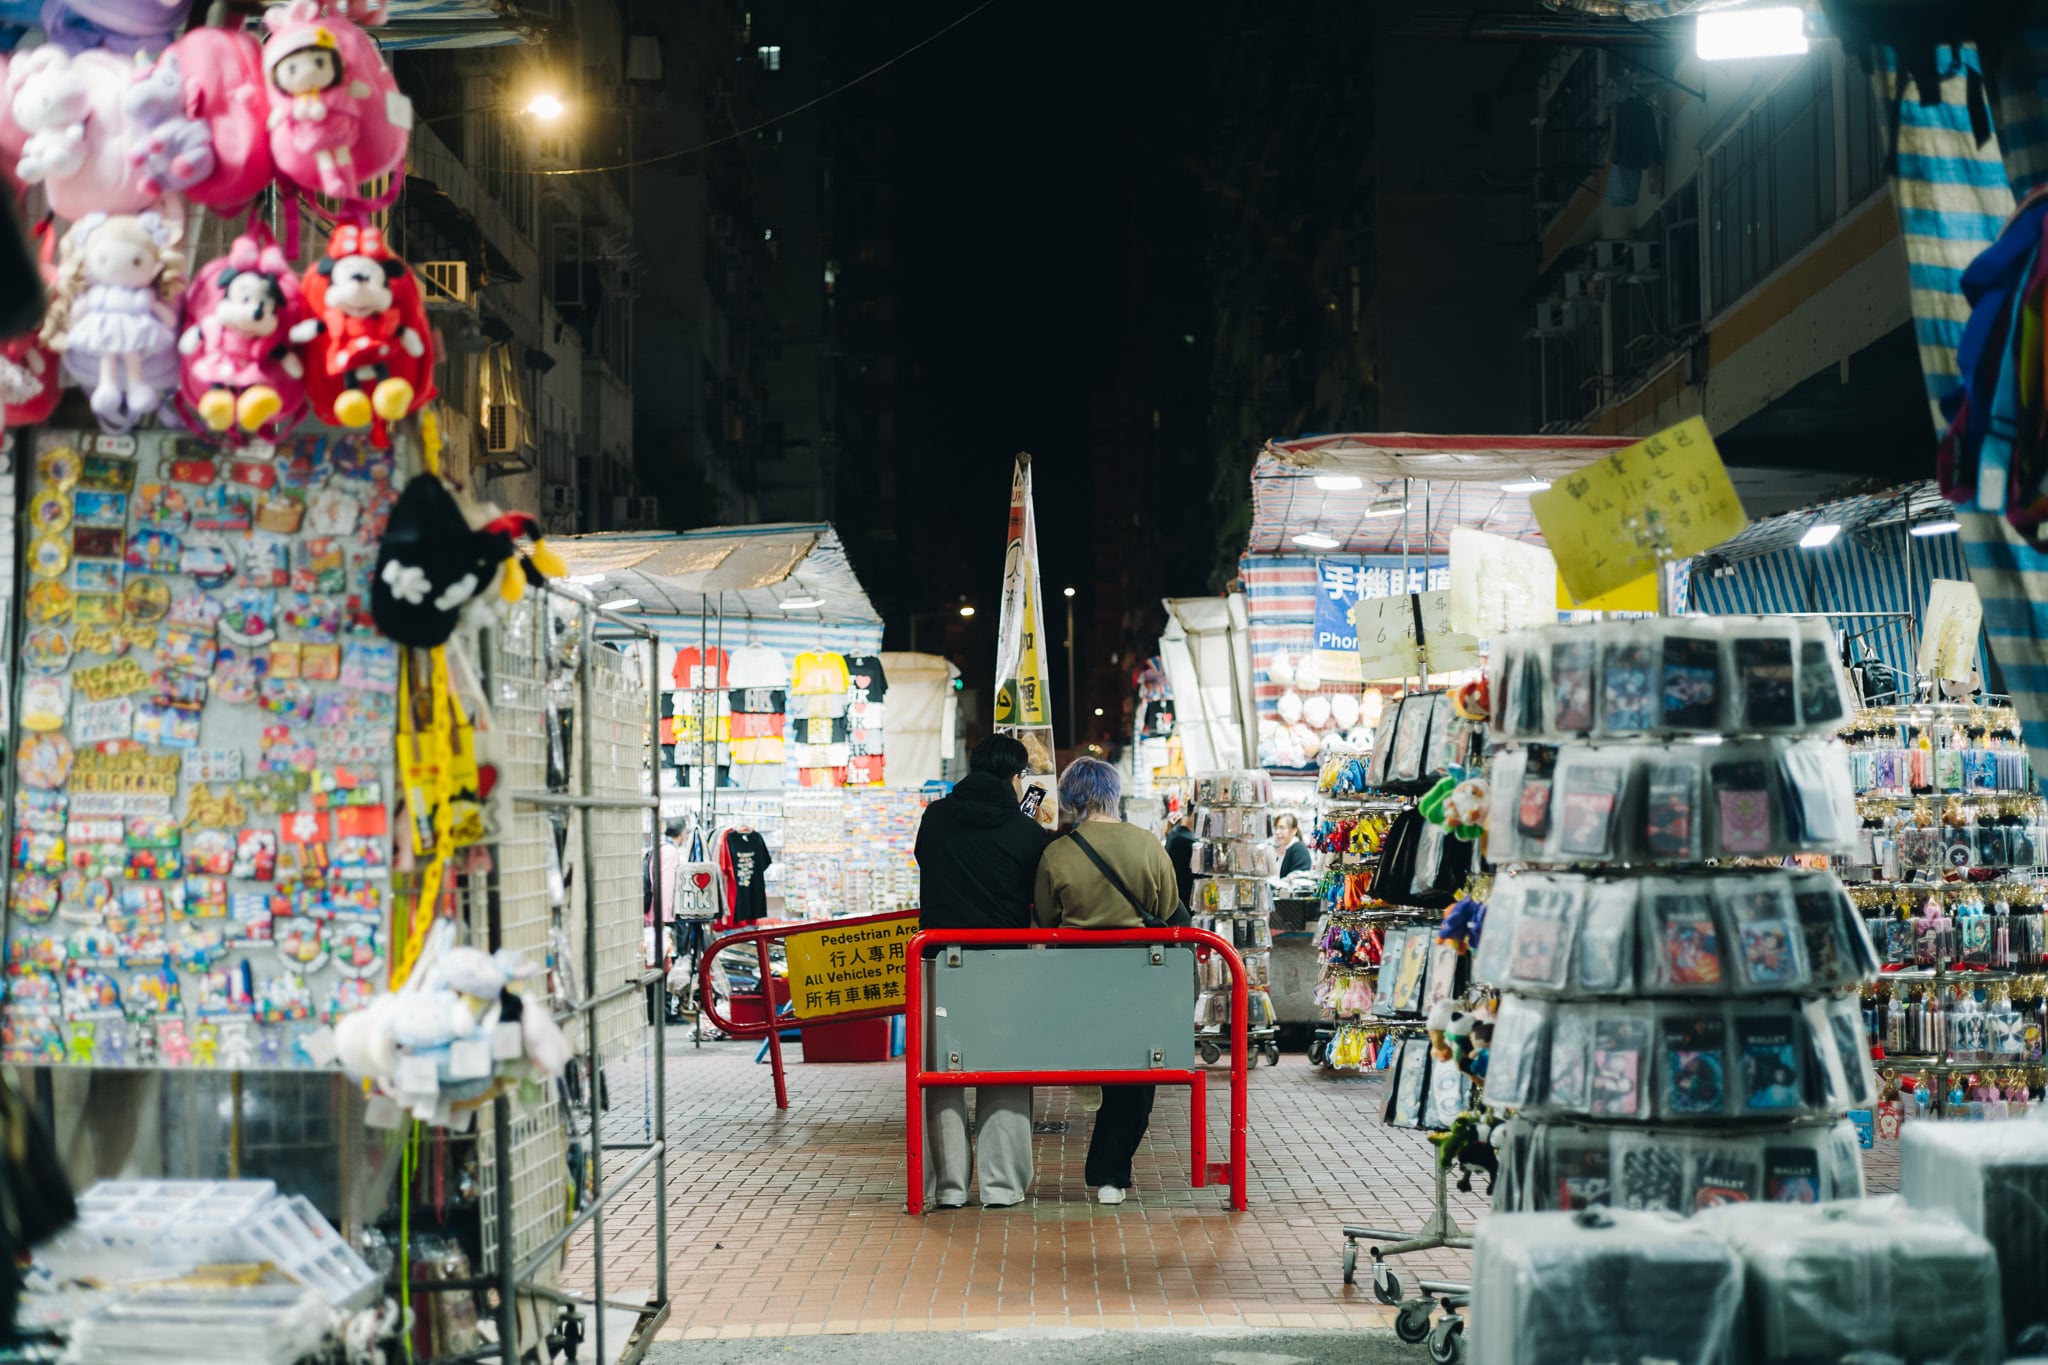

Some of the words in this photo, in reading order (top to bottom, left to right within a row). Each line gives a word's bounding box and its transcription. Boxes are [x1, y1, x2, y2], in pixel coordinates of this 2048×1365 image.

[682, 890, 713, 911] HK
[821, 929, 891, 946] Pedestrian
[829, 940, 909, 968] 行人專用
[804, 975, 824, 987] All
[827, 967, 882, 983] Vehicles
[804, 981, 907, 1009] 所有車輛禁
[1773, 1166, 1812, 1176] WALLET
[1703, 1175, 1745, 1189] WALLET
